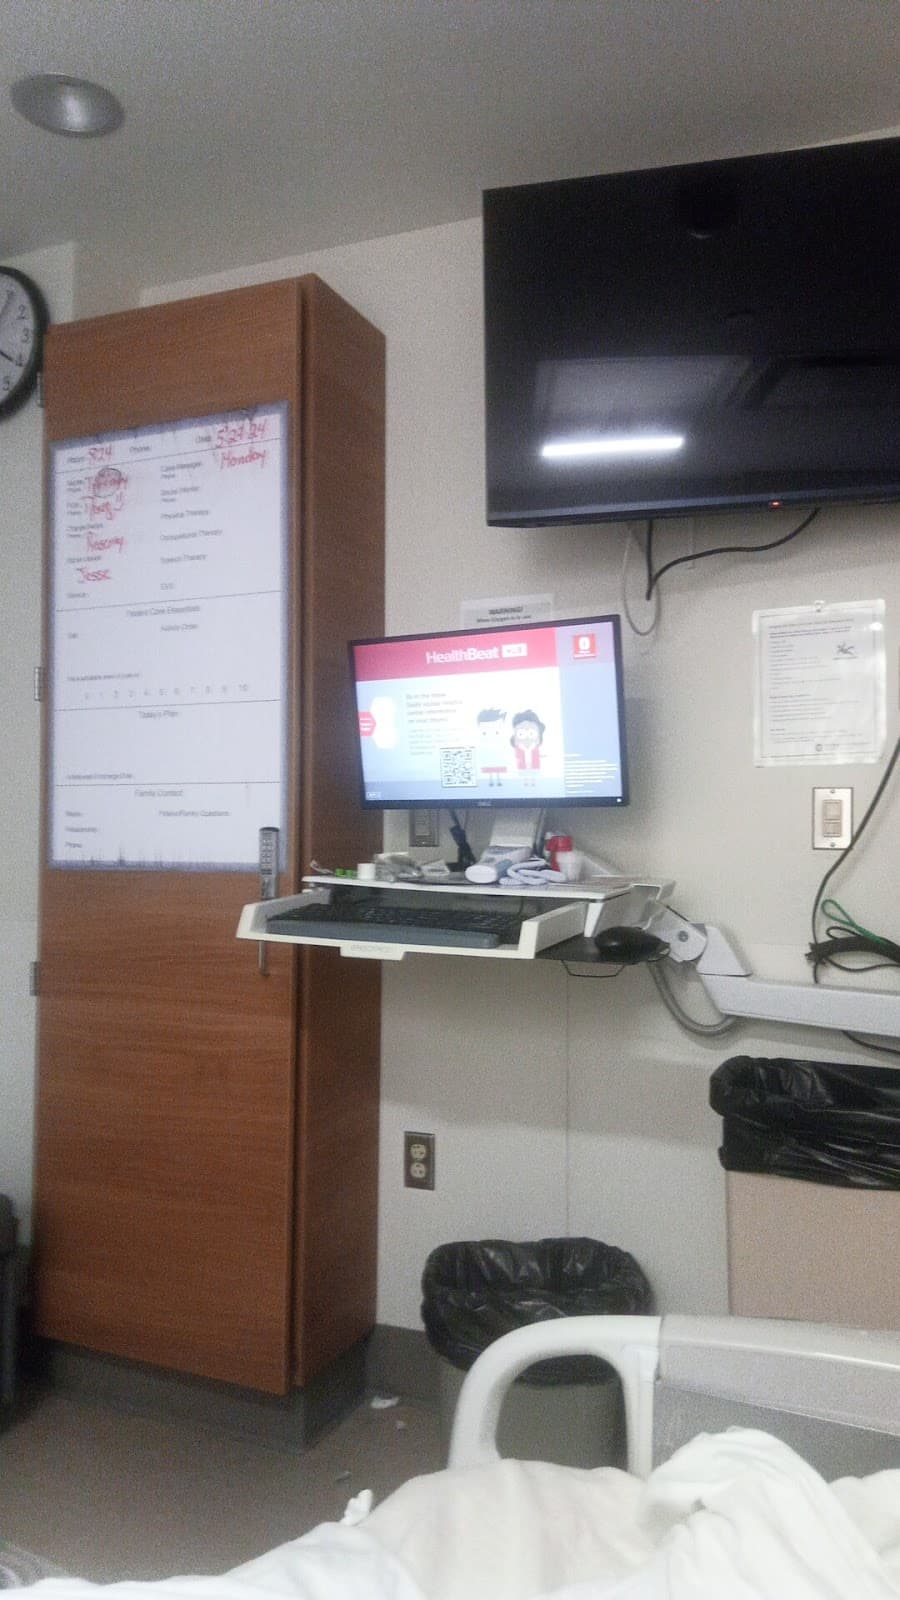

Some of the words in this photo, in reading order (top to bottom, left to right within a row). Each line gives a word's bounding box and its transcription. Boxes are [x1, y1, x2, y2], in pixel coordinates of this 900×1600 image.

[16, 304, 26, 321] 2
[22, 328, 30, 344] 3
[15, 353, 24, 367] 4
[2, 375, 10, 392] 5
[220, 447, 266, 470] Monday
[425, 646, 499, 665] HealthBeat
